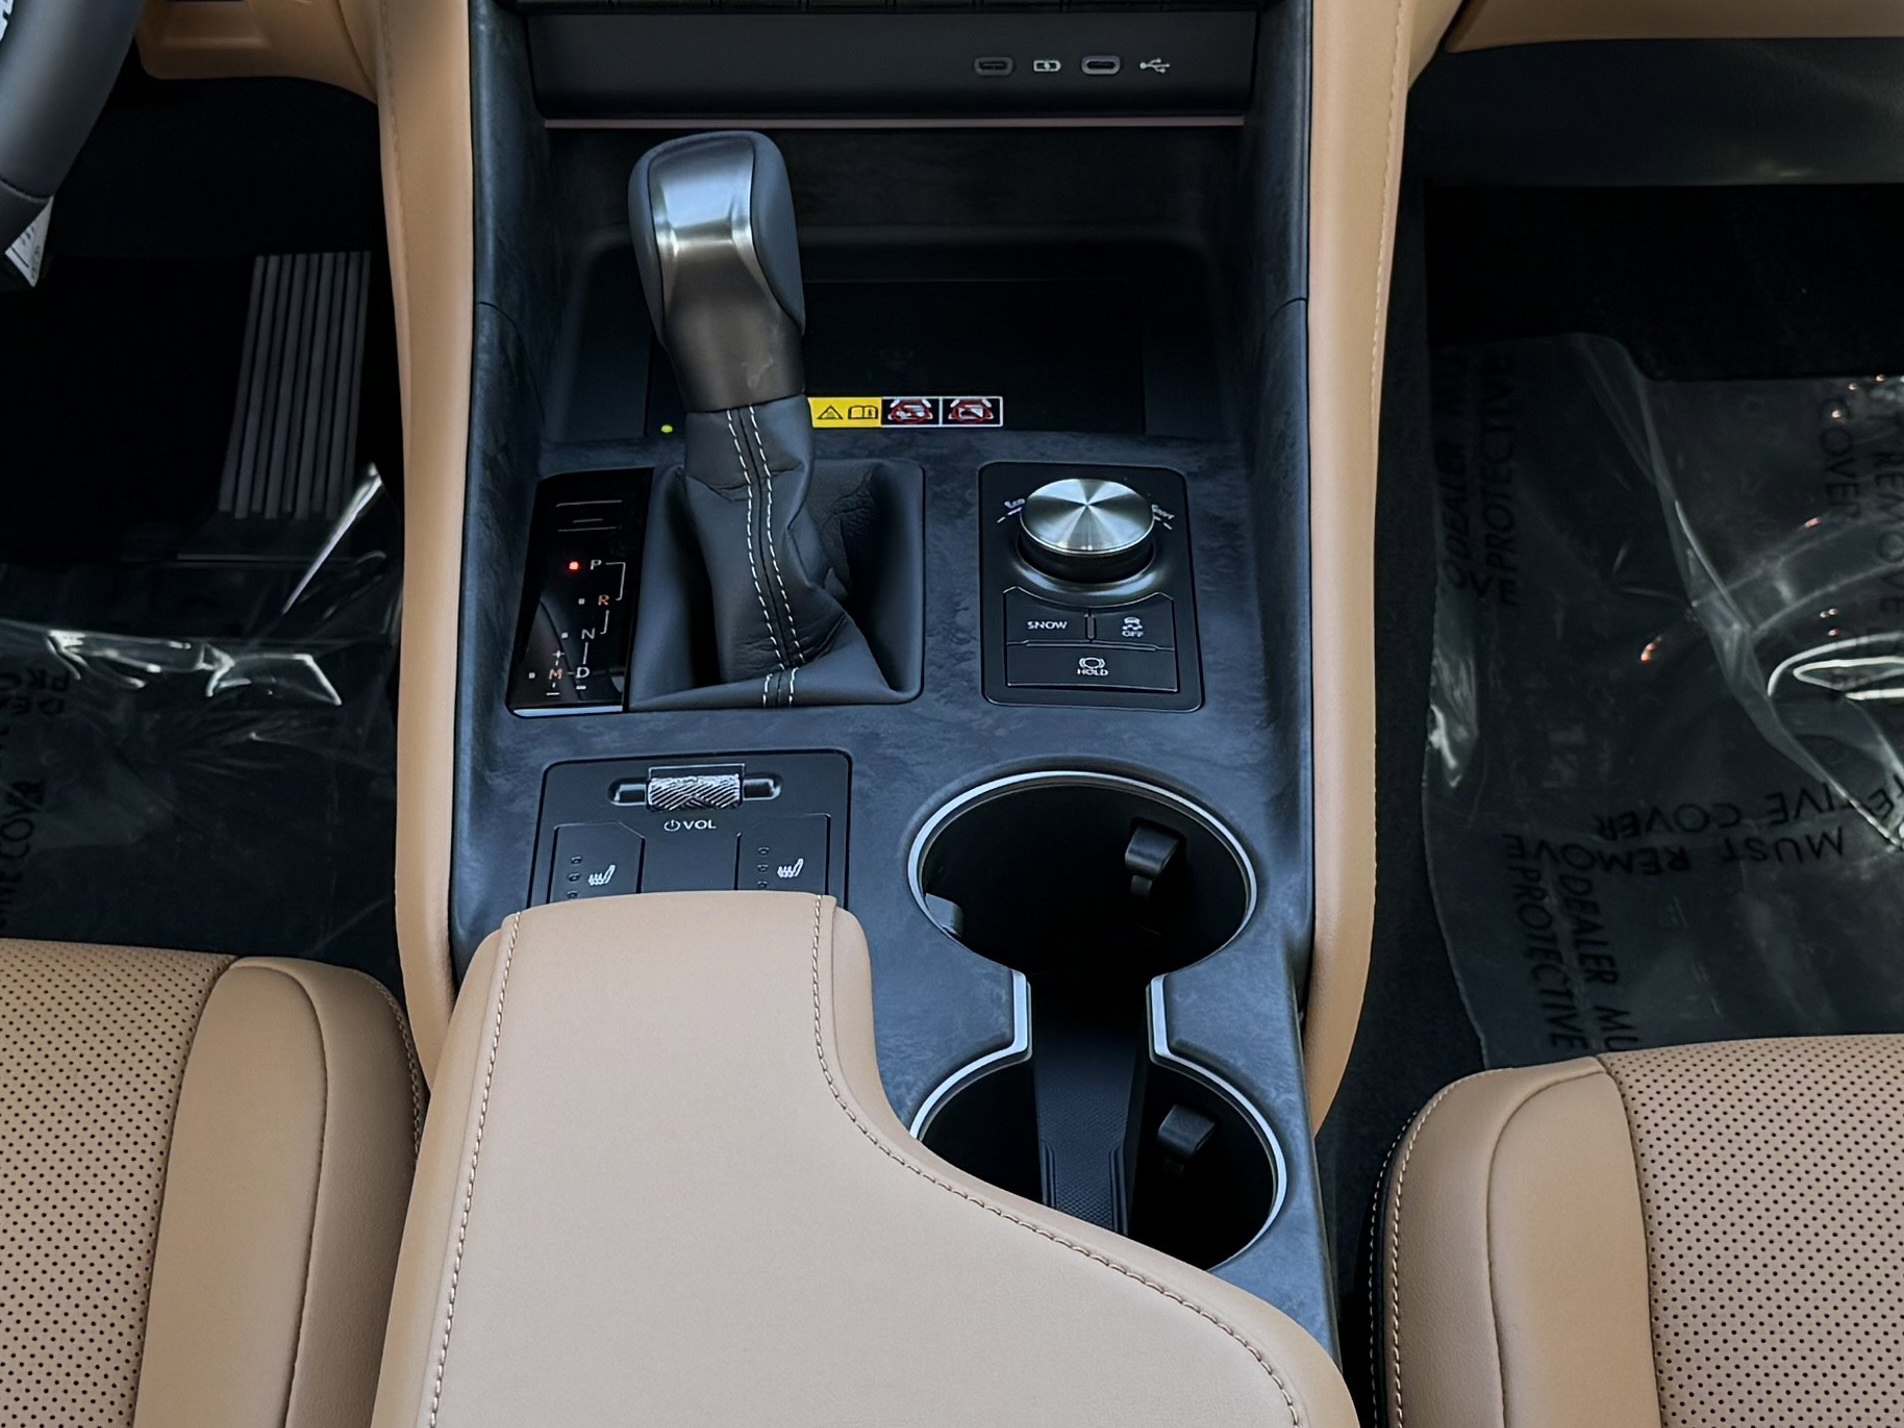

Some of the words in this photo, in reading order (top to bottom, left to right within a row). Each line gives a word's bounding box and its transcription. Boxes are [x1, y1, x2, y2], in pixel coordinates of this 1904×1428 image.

[590, 559, 602, 570] P
[598, 594, 610, 606] R
[1027, 621, 1068, 630] SNOW
[581, 627, 596, 640] N
[548, 668, 563, 680] M
[575, 666, 590, 679] D
[1077, 668, 1108, 677] HOLD
[682, 820, 717, 830] VOL
